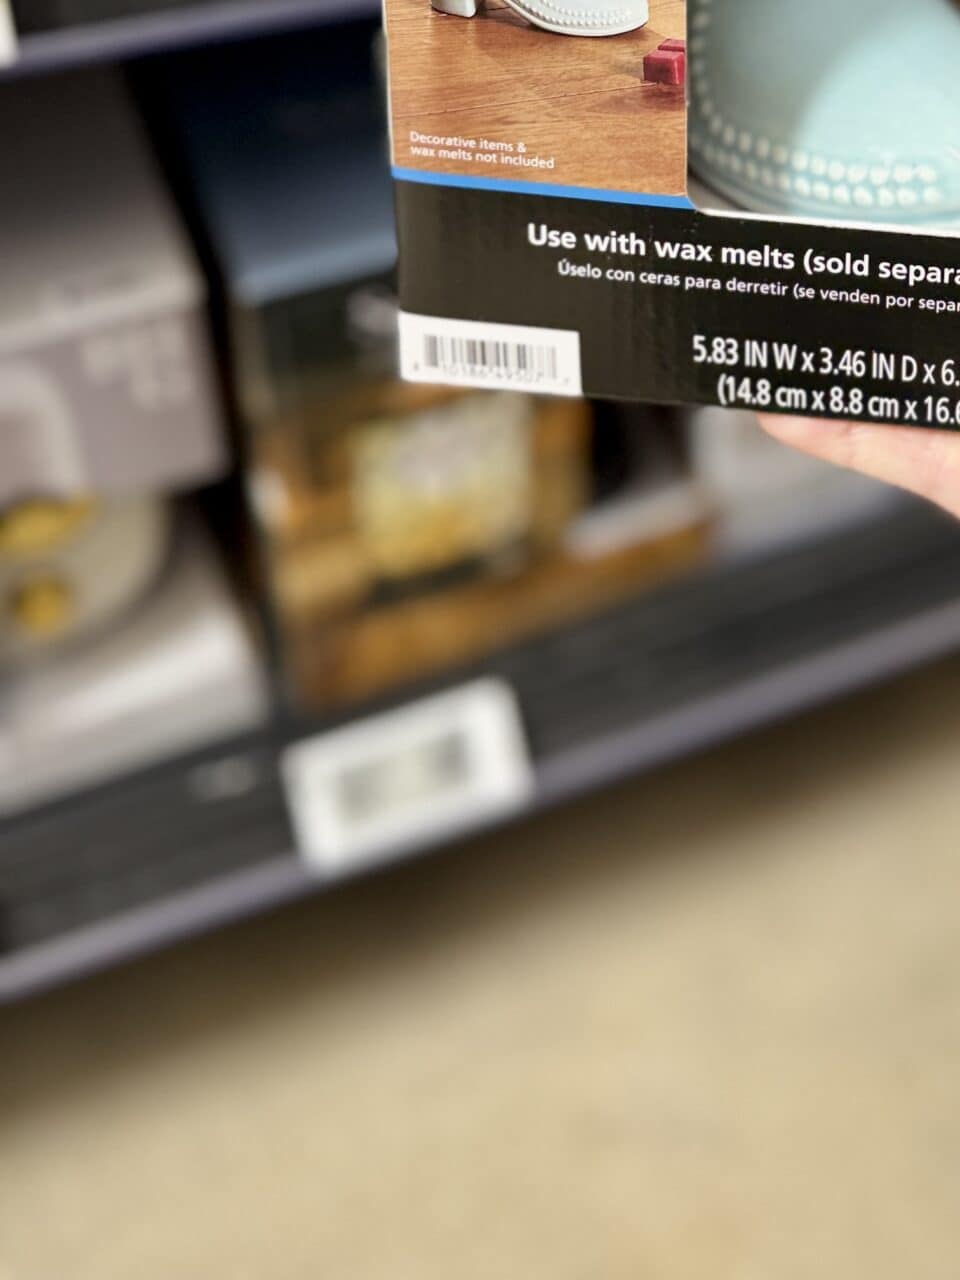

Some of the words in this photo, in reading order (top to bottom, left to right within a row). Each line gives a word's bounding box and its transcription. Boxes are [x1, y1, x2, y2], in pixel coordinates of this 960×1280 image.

[409, 130, 477, 149] Decorative
[479, 137, 513, 153] items
[516, 141, 527, 153] &
[410, 145, 436, 157] wax
[438, 148, 473, 161] melts
[475, 152, 497, 164] not
[500, 154, 555, 169] included
[527, 222, 577, 249] Use
[583, 230, 647, 257] with
[654, 240, 713, 263] wax
[720, 245, 796, 270] melts
[803, 248, 870, 277] (sold
[557, 258, 602, 279] Úselo
[605, 269, 636, 283] con
[639, 272, 681, 287] ceras
[684, 276, 722, 291] para
[725, 277, 789, 297] derretir
[793, 282, 816, 300] (se
[820, 289, 880, 306] venden
[885, 294, 914, 309] por
[692, 334, 740, 366] 5.83
[744, 339, 768, 369] IN
[772, 342, 798, 371] W
[801, 350, 815, 373] x
[818, 347, 867, 378] 3.46
[872, 351, 895, 381] IN
[901, 354, 918, 382] D
[922, 363, 936, 385] x
[717, 373, 771, 406] (14.8
[775, 386, 807, 409] cm
[811, 389, 825, 411] x
[829, 386, 864, 415] 8.8
[867, 395, 900, 419] cm
[904, 399, 918, 421] x
